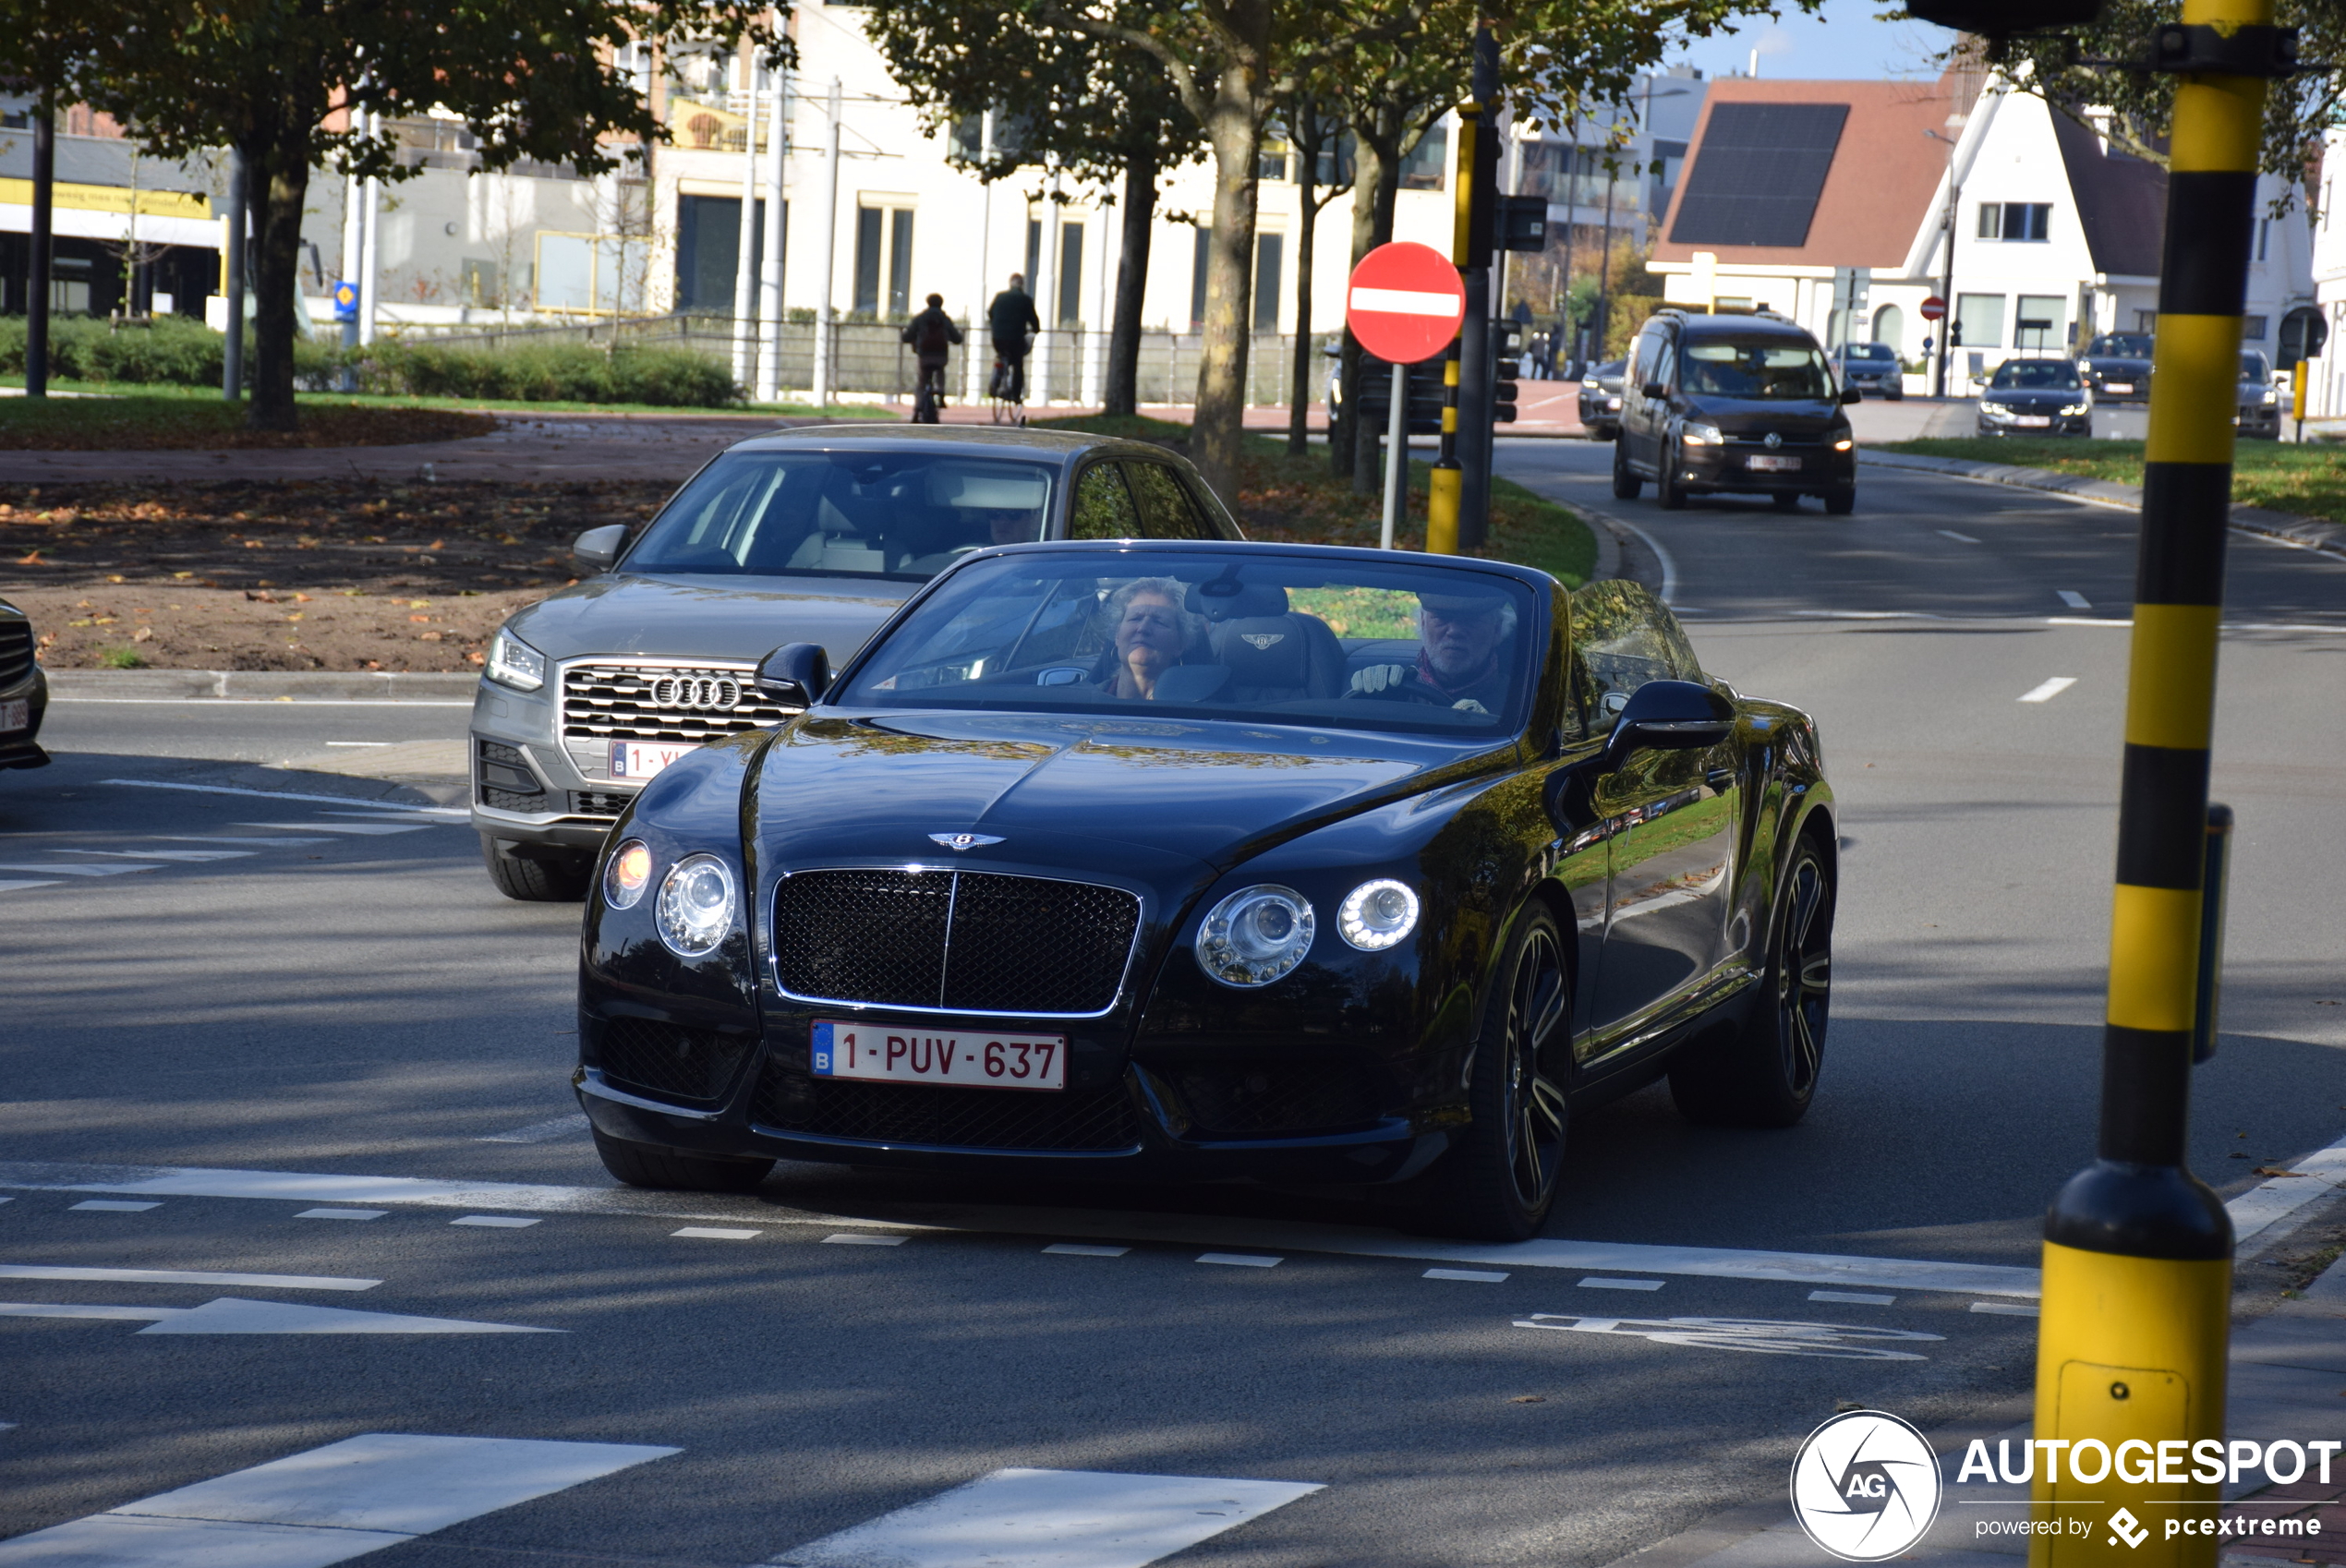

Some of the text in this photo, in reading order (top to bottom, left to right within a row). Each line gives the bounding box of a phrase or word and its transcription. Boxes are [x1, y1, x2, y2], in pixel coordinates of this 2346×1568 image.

[614, 761, 624, 772] B
[816, 1032, 1057, 1080] B 1-PUV-637
